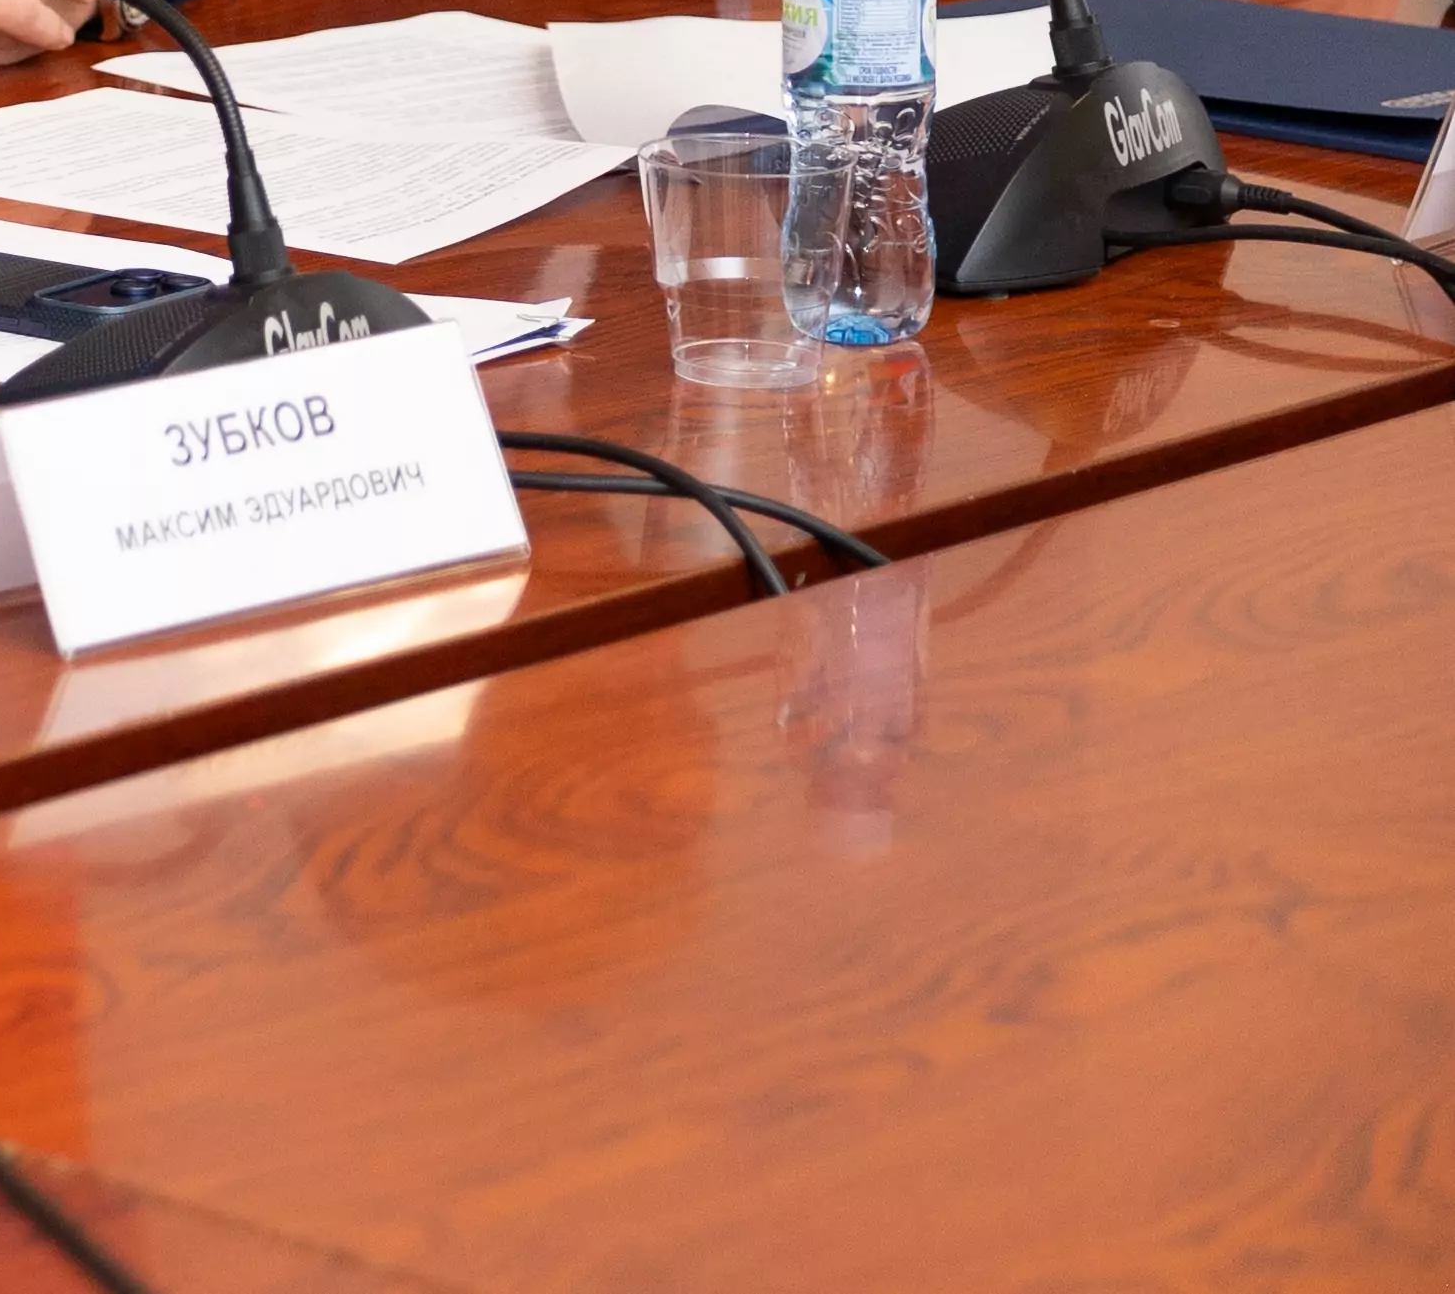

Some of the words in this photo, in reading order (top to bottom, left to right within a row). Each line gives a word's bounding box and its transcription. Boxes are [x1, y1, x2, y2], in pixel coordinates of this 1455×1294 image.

[1104, 87, 1183, 167] GlavCom
[164, 394, 337, 468] ЗУБКОВ
[115, 498, 238, 555] МАКСИМ
[248, 461, 426, 526] ЭДУАРДОВИЧ
